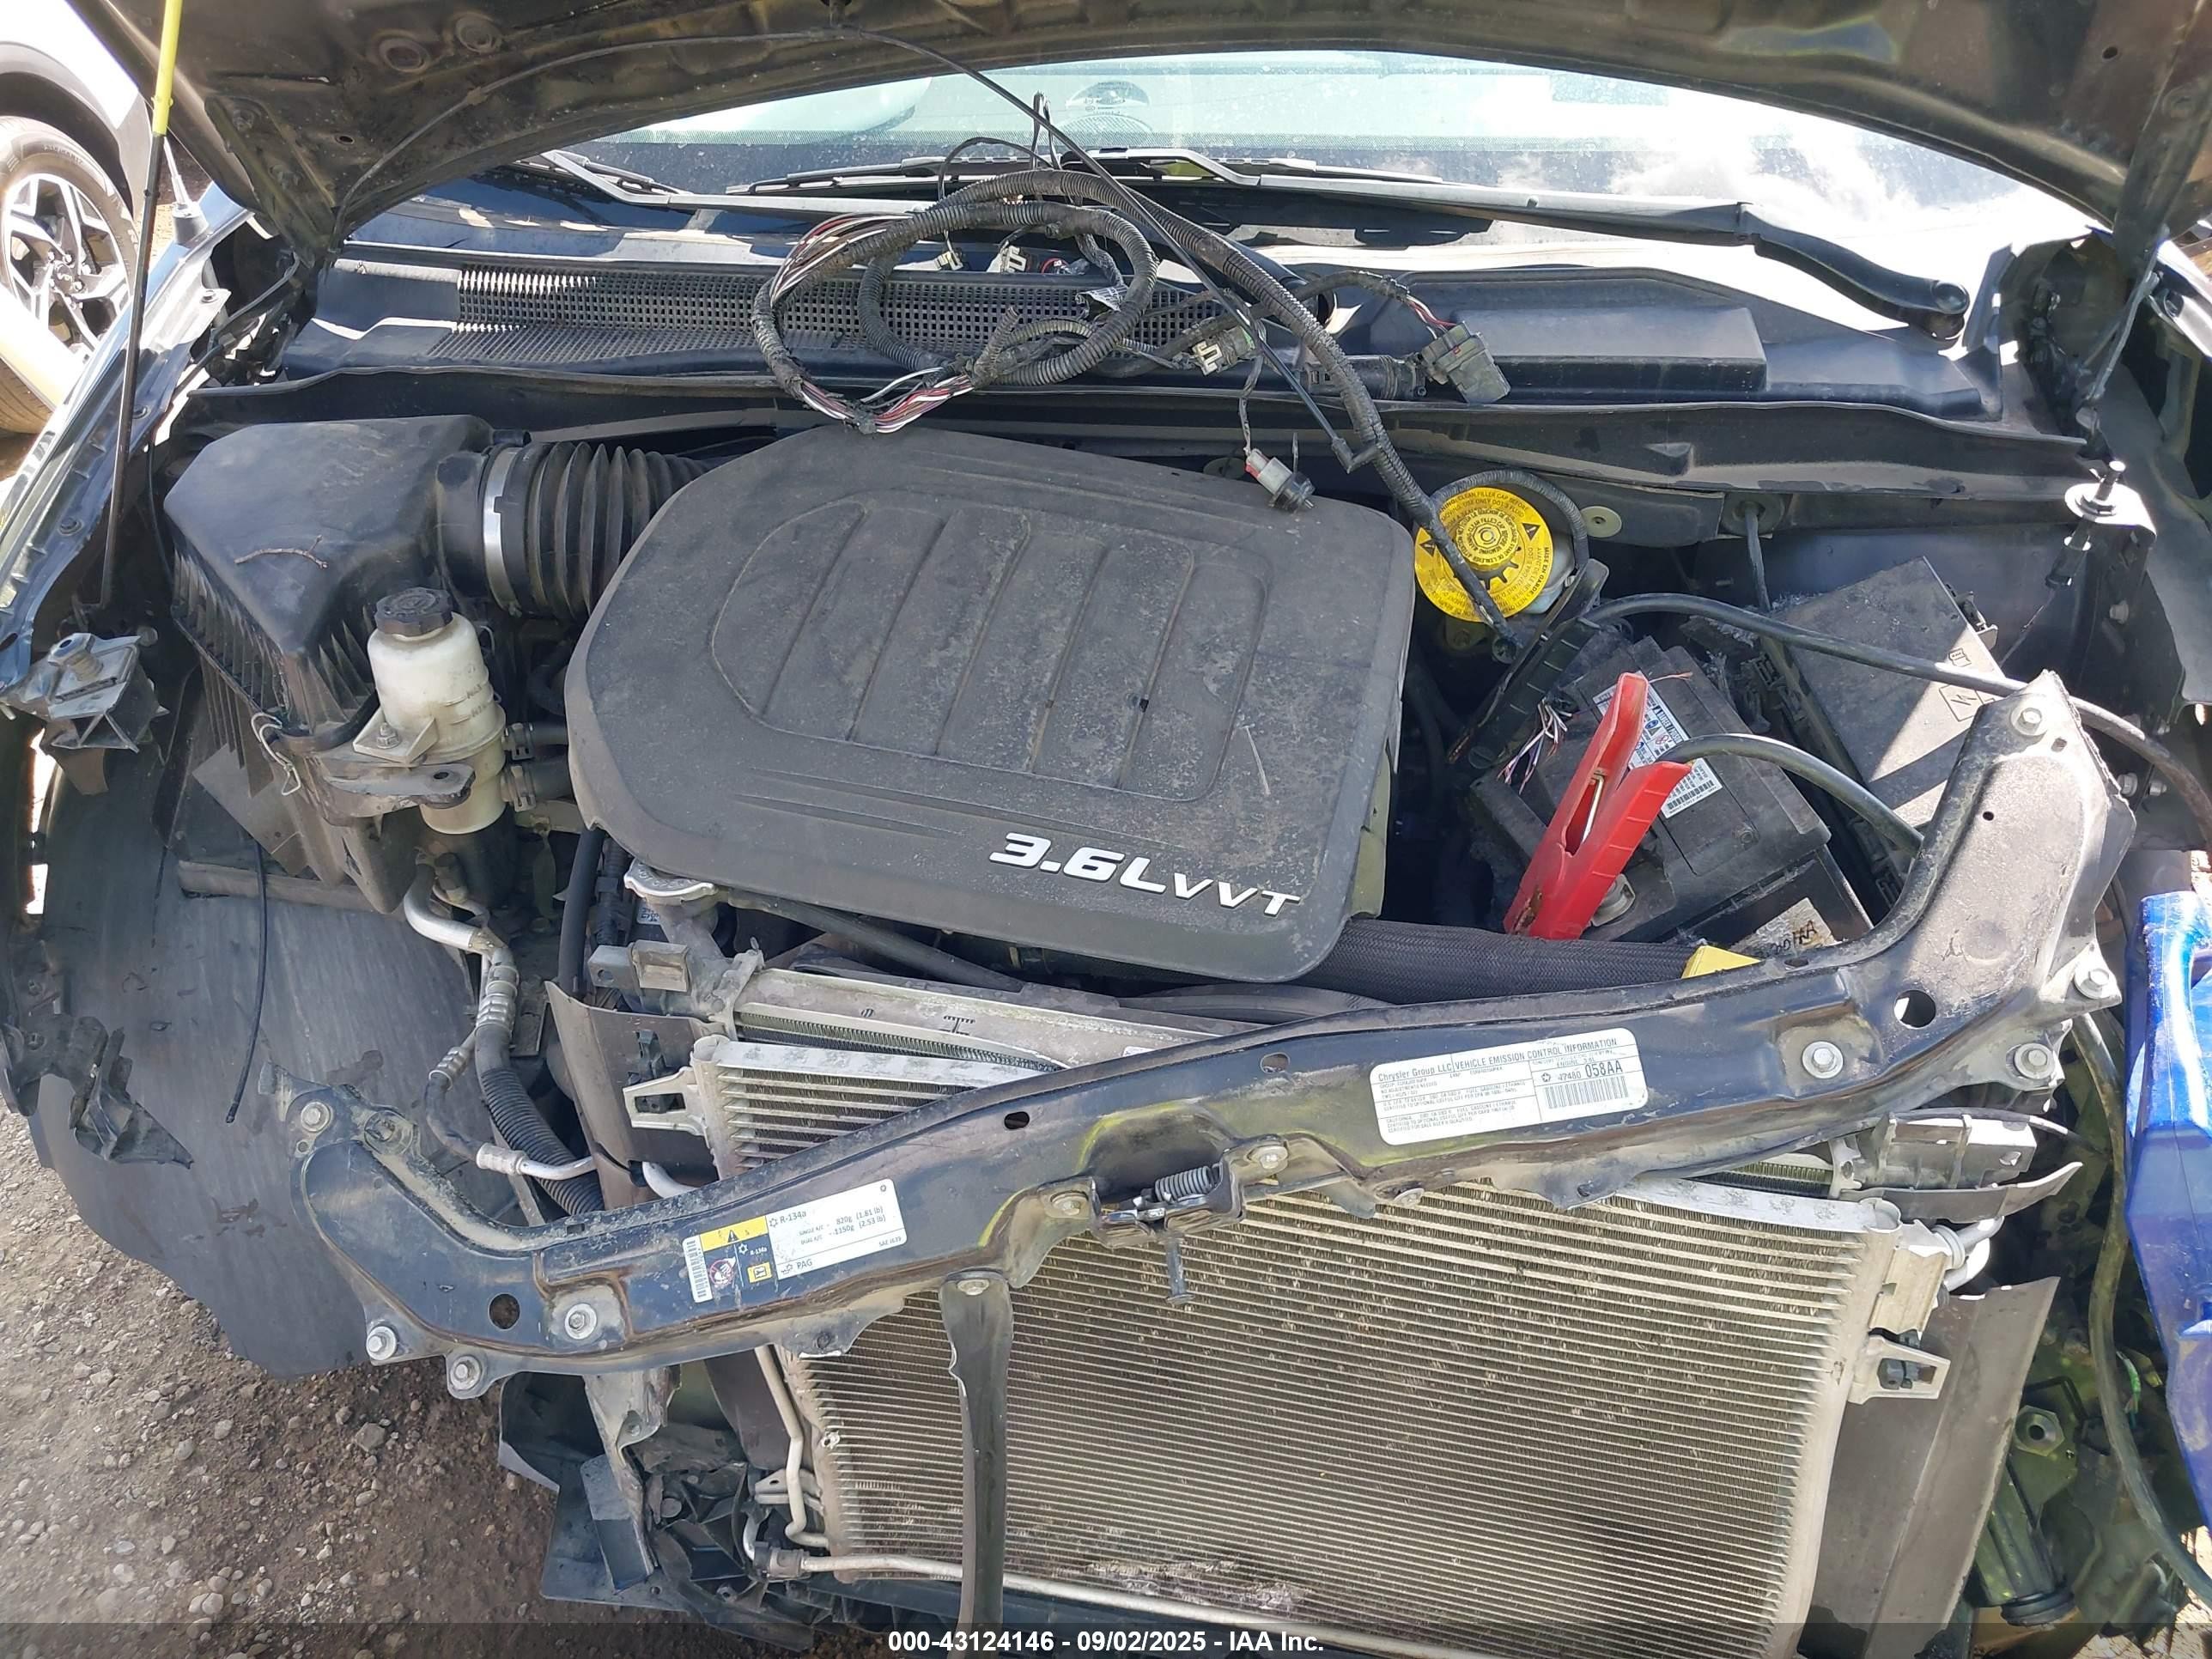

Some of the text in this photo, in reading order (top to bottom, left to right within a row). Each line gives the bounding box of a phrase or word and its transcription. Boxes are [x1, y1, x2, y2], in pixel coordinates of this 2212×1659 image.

[1496, 492, 1508, 501] CAP
[1540, 564, 1547, 574] EN
[1377, 1069, 1409, 1082] Chrysler
[1412, 1065, 1435, 1077] Group
[1437, 1062, 1451, 1073] LLC
[1455, 1057, 1486, 1070] VEHICLE
[1488, 1052, 1525, 1065] EMISSION
[1527, 1045, 1561, 1059] CONTROL
[1564, 1037, 1617, 1053] INFORMATION
[1584, 1059, 1623, 1078] 058AA
[779, 1209, 806, 1223] R-134a
[836, 1214, 853, 1225] 820g
[855, 1208, 872, 1220] (1.81
[858, 1217, 876, 1229] (2.53
[796, 1258, 813, 1269] PAG
